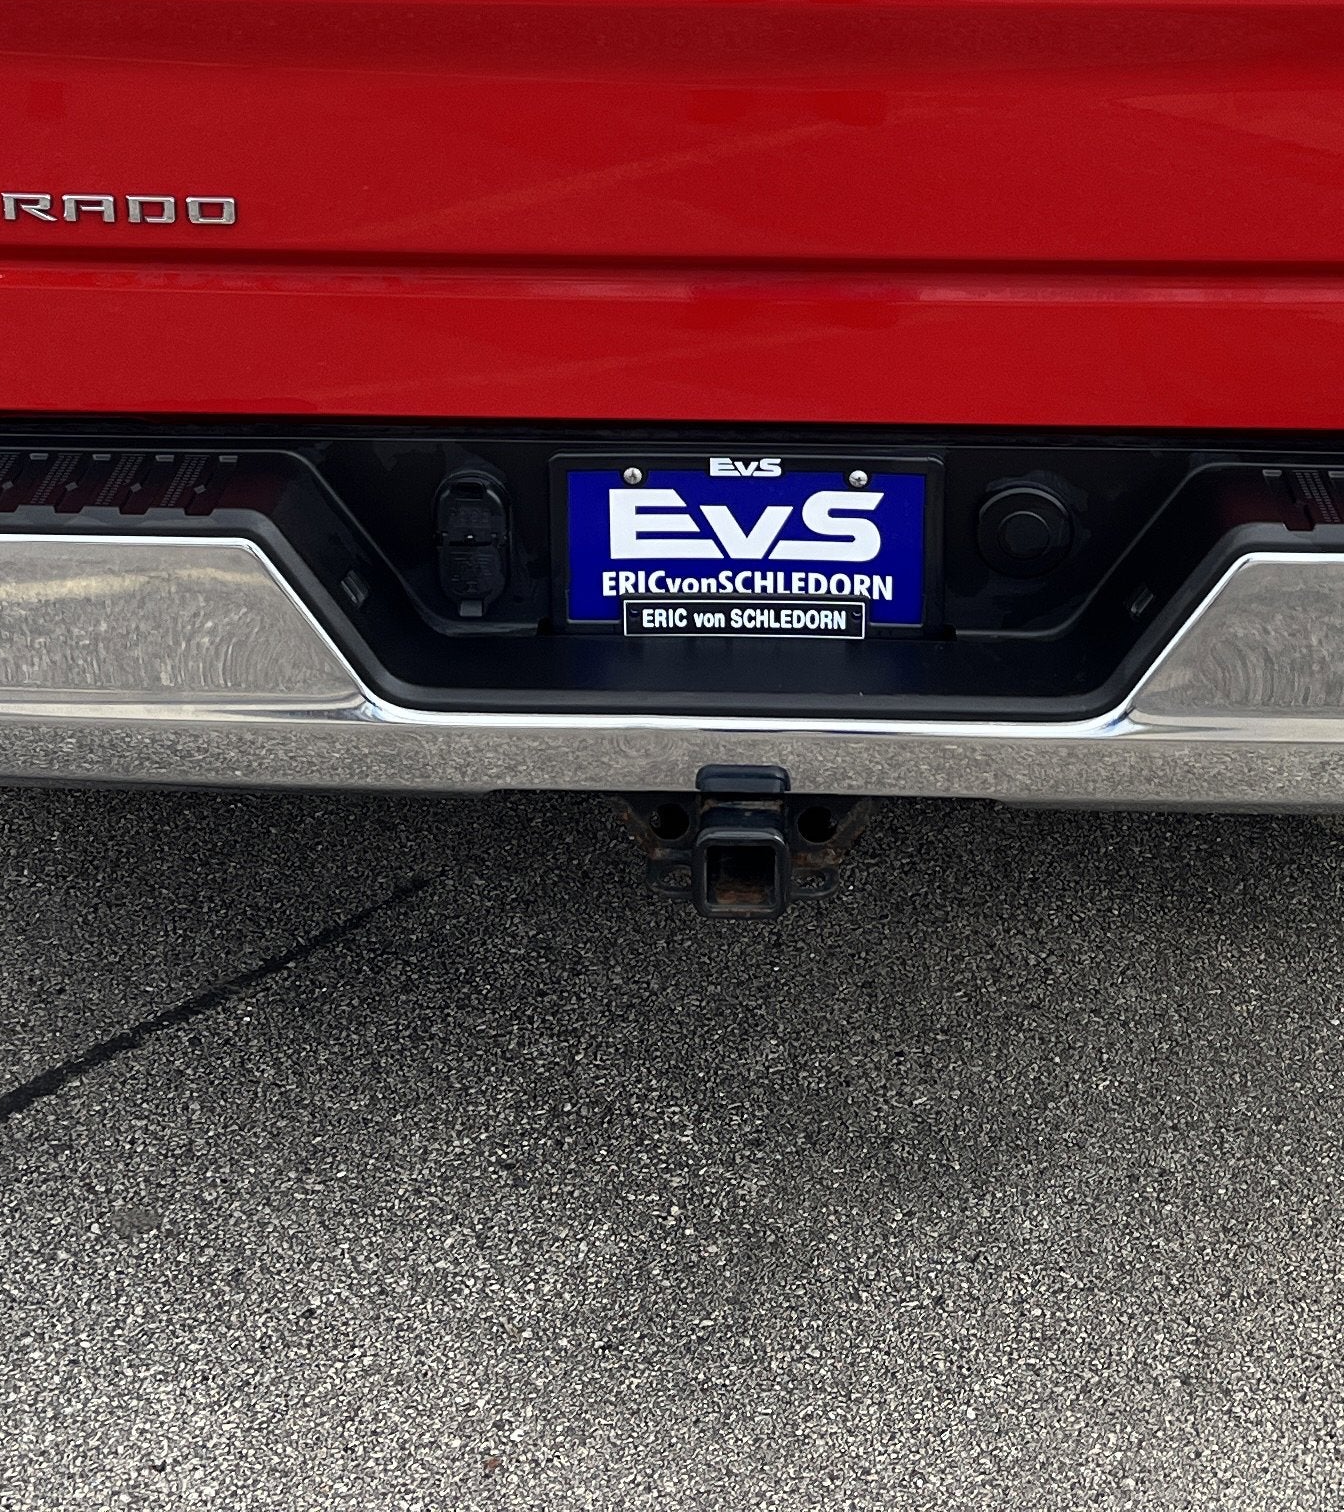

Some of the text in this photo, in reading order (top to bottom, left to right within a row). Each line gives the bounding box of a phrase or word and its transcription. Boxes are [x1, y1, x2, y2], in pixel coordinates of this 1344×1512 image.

[601, 569, 893, 601] ERICvonSCHLEDORN
[642, 607, 847, 630] ERIC von SCHLEDORN
